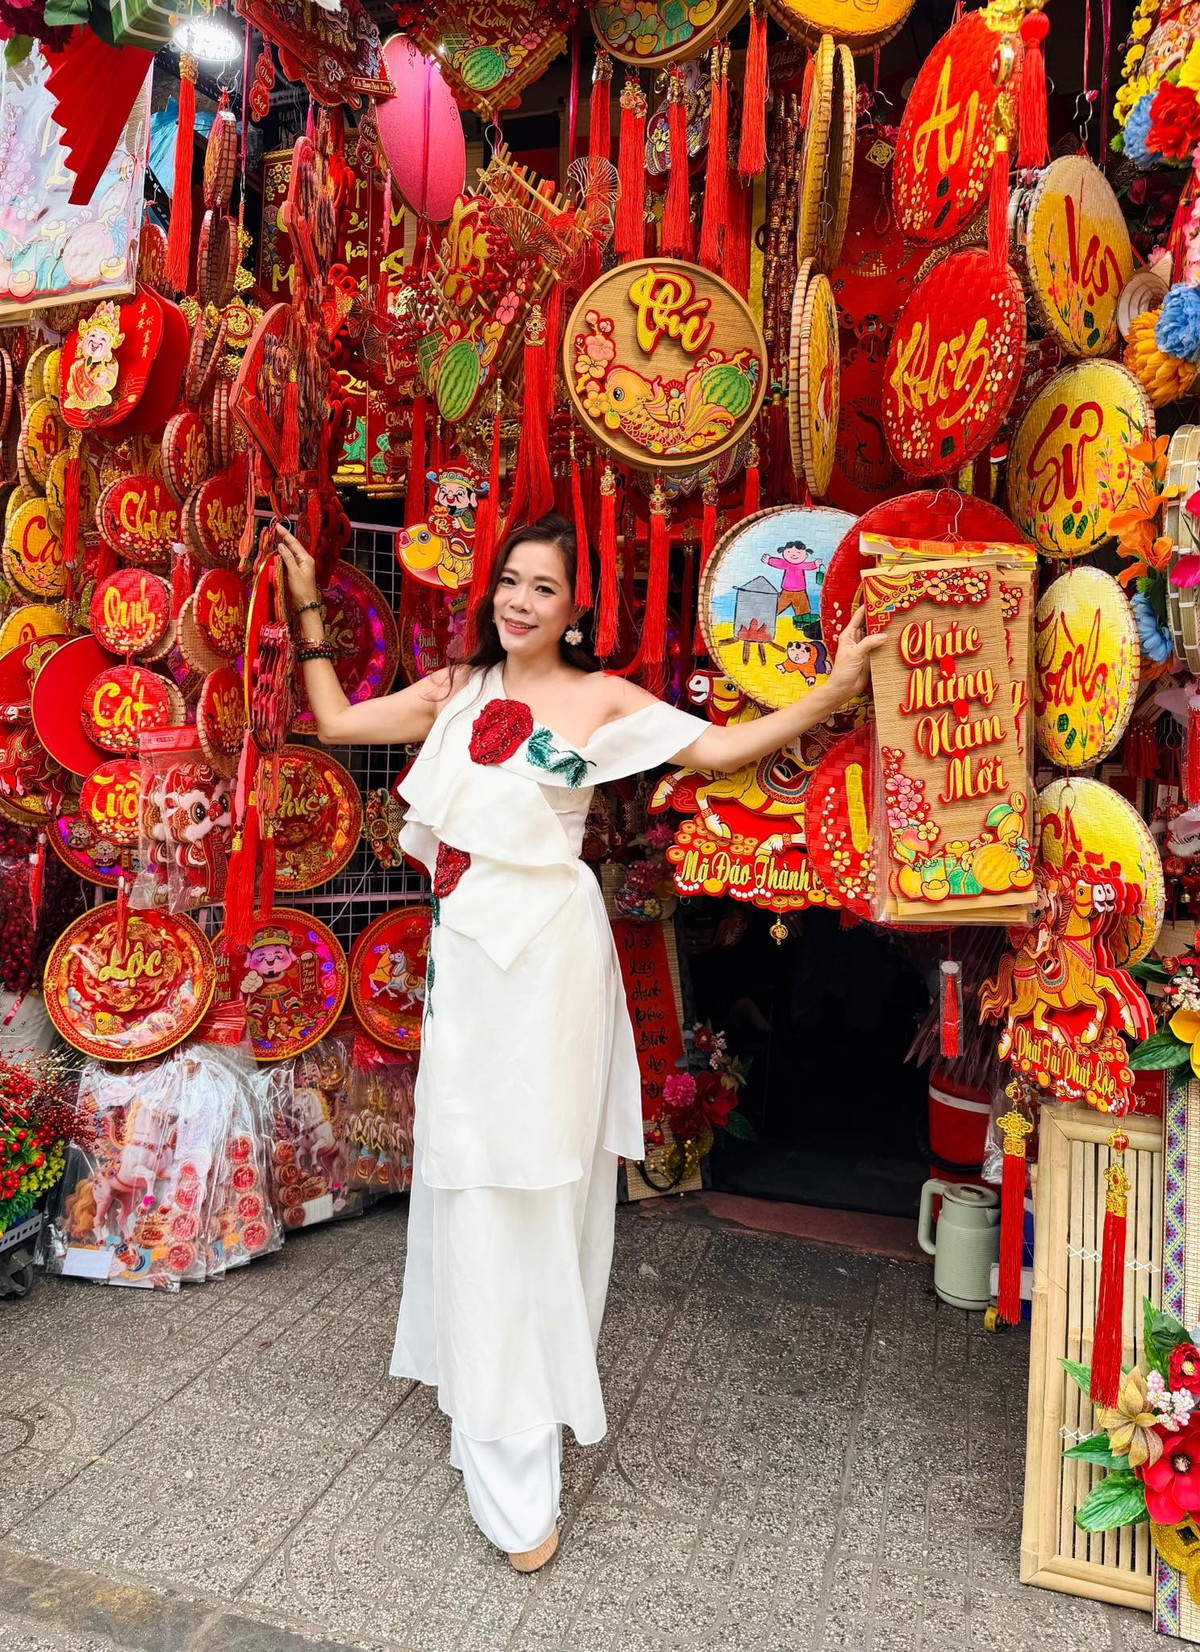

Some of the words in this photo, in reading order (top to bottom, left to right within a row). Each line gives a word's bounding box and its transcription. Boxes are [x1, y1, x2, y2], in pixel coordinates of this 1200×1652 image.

[913, 55, 979, 174] An
[629, 268, 711, 351] Phú
[1027, 401, 1104, 514] Sự
[900, 619, 982, 665] Chúc
[899, 666, 999, 713] Mừng
[917, 711, 1006, 757] Năm
[939, 755, 1009, 804] Mới
[681, 850, 708, 882] Mã
[711, 851, 752, 885] Đáo
[754, 854, 811, 891] Thành
[98, 939, 163, 987] Lộc
[1015, 1025, 1042, 1065] Phát
[1042, 1038, 1061, 1076] Tài
[1061, 1047, 1091, 1089] Phát
[1092, 1060, 1117, 1099] Lộc
